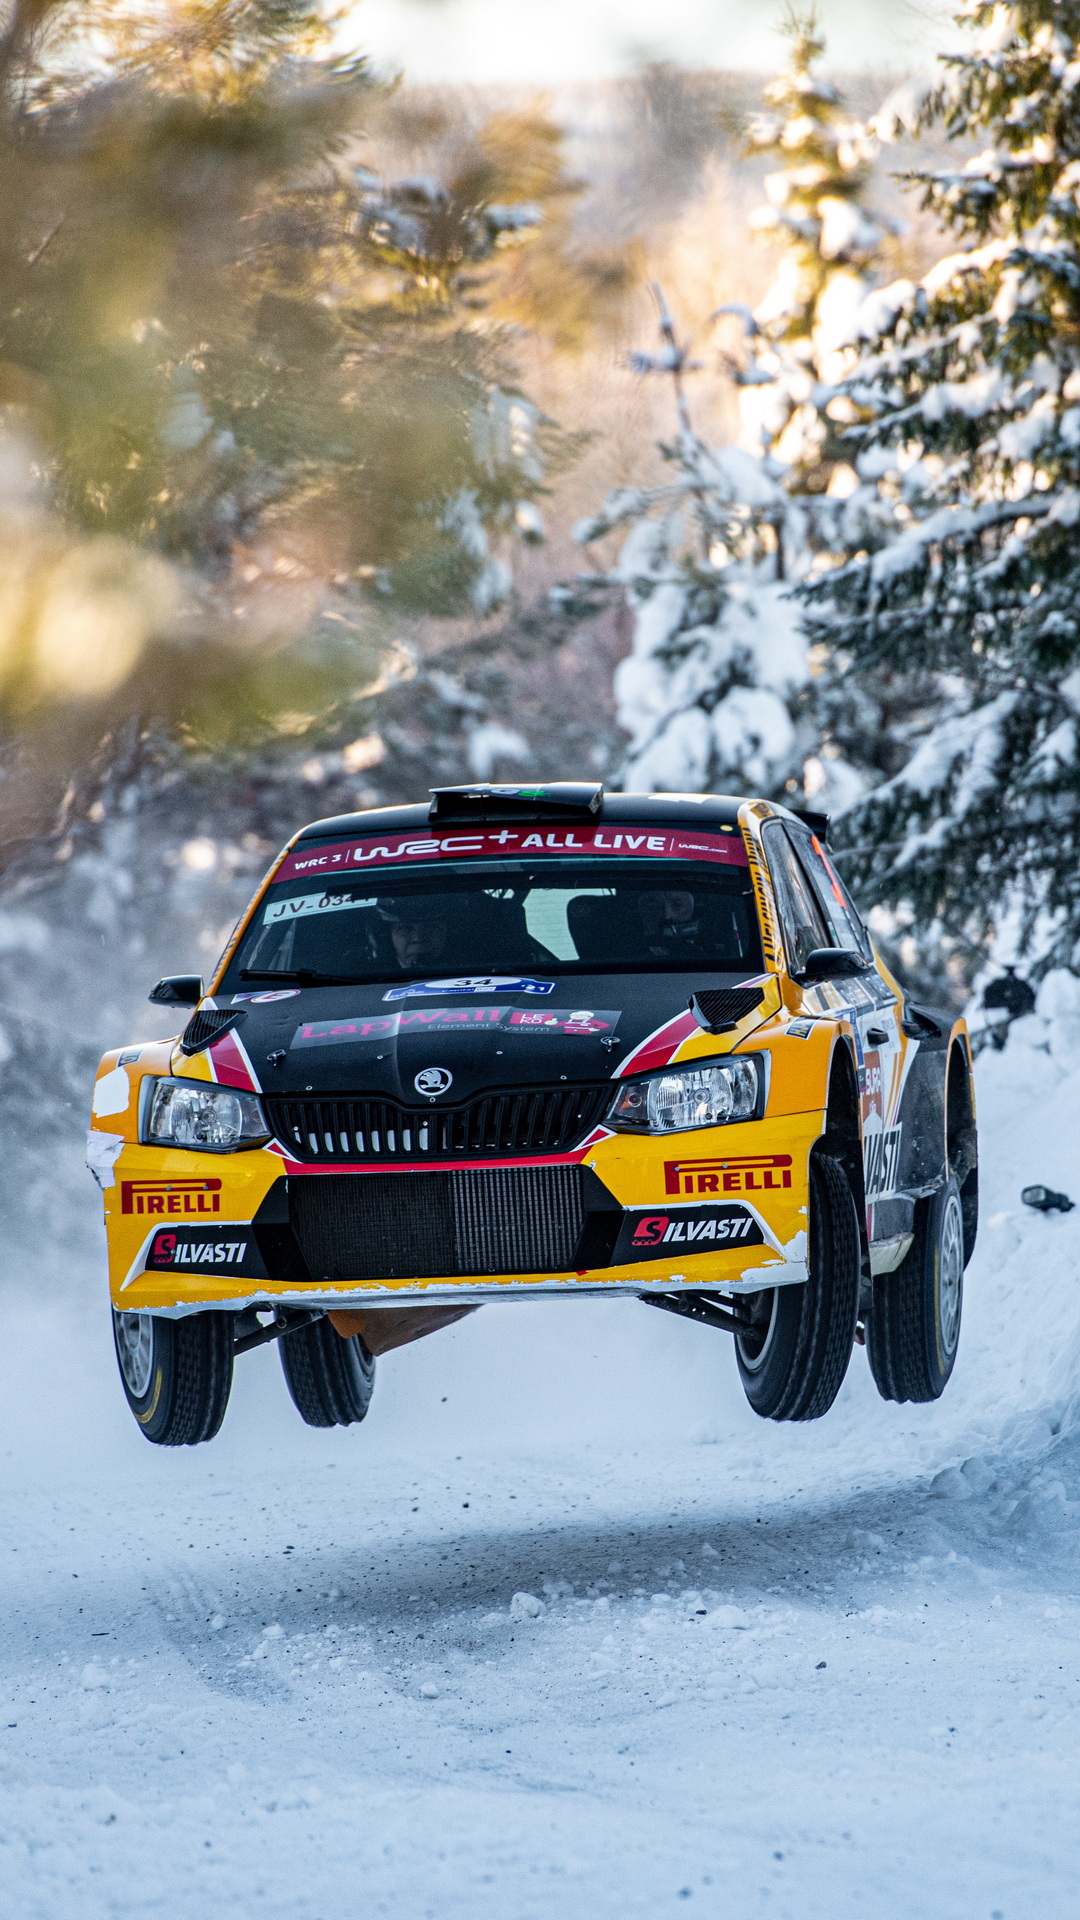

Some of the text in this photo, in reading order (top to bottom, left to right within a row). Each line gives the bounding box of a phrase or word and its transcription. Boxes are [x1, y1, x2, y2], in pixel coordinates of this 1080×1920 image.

[520, 833, 584, 848] ALL
[593, 833, 667, 851] LIVE
[294, 853, 342, 870] WRC 3
[453, 978, 493, 987] 34
[301, 1009, 501, 1039] LapWall
[427, 1022, 550, 1032] Element System
[663, 1154, 793, 1195] PIRELLI
[121, 1178, 222, 1214] PIRELLI
[632, 1216, 754, 1247] SILVASTI
[154, 1233, 248, 1264] SILVASTI
